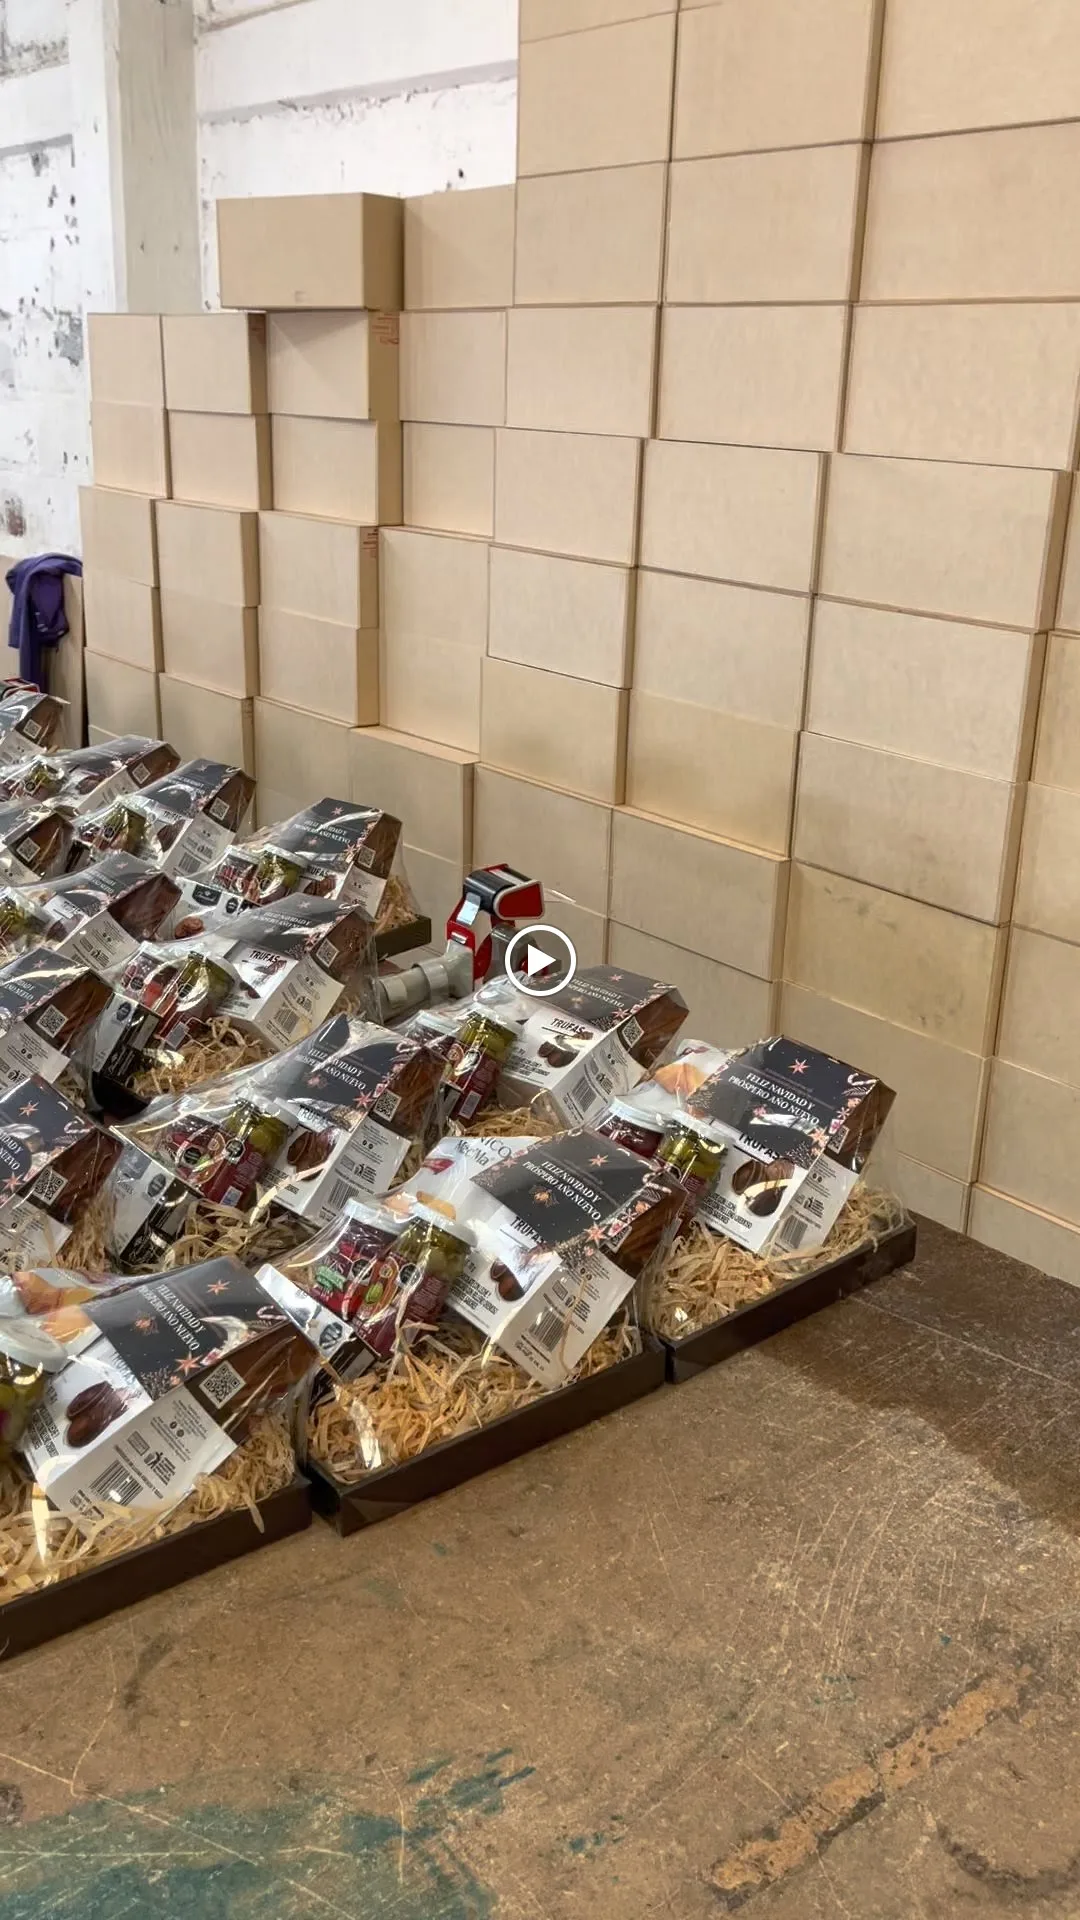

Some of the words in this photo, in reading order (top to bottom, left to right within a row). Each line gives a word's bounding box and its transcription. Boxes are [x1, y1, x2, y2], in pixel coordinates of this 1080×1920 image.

[249, 950, 282, 964] TRUFAS
[550, 1018, 586, 1036] TRUFAS
[340, 1071, 367, 1092] NUEVO
[745, 1072, 770, 1090] FELIZ
[769, 1083, 809, 1111] NAVIDAD
[807, 1102, 816, 1113] Y
[786, 1102, 820, 1127] NUEVO
[541, 1160, 563, 1178] FELIZ
[560, 1169, 595, 1200] NAVIDAD
[592, 1192, 602, 1204] Y
[572, 1193, 602, 1222] NUEVO
[509, 1216, 545, 1244] TRUFAS
[175, 1322, 201, 1352] NUEVO
[197, 1324, 206, 1335] Y
